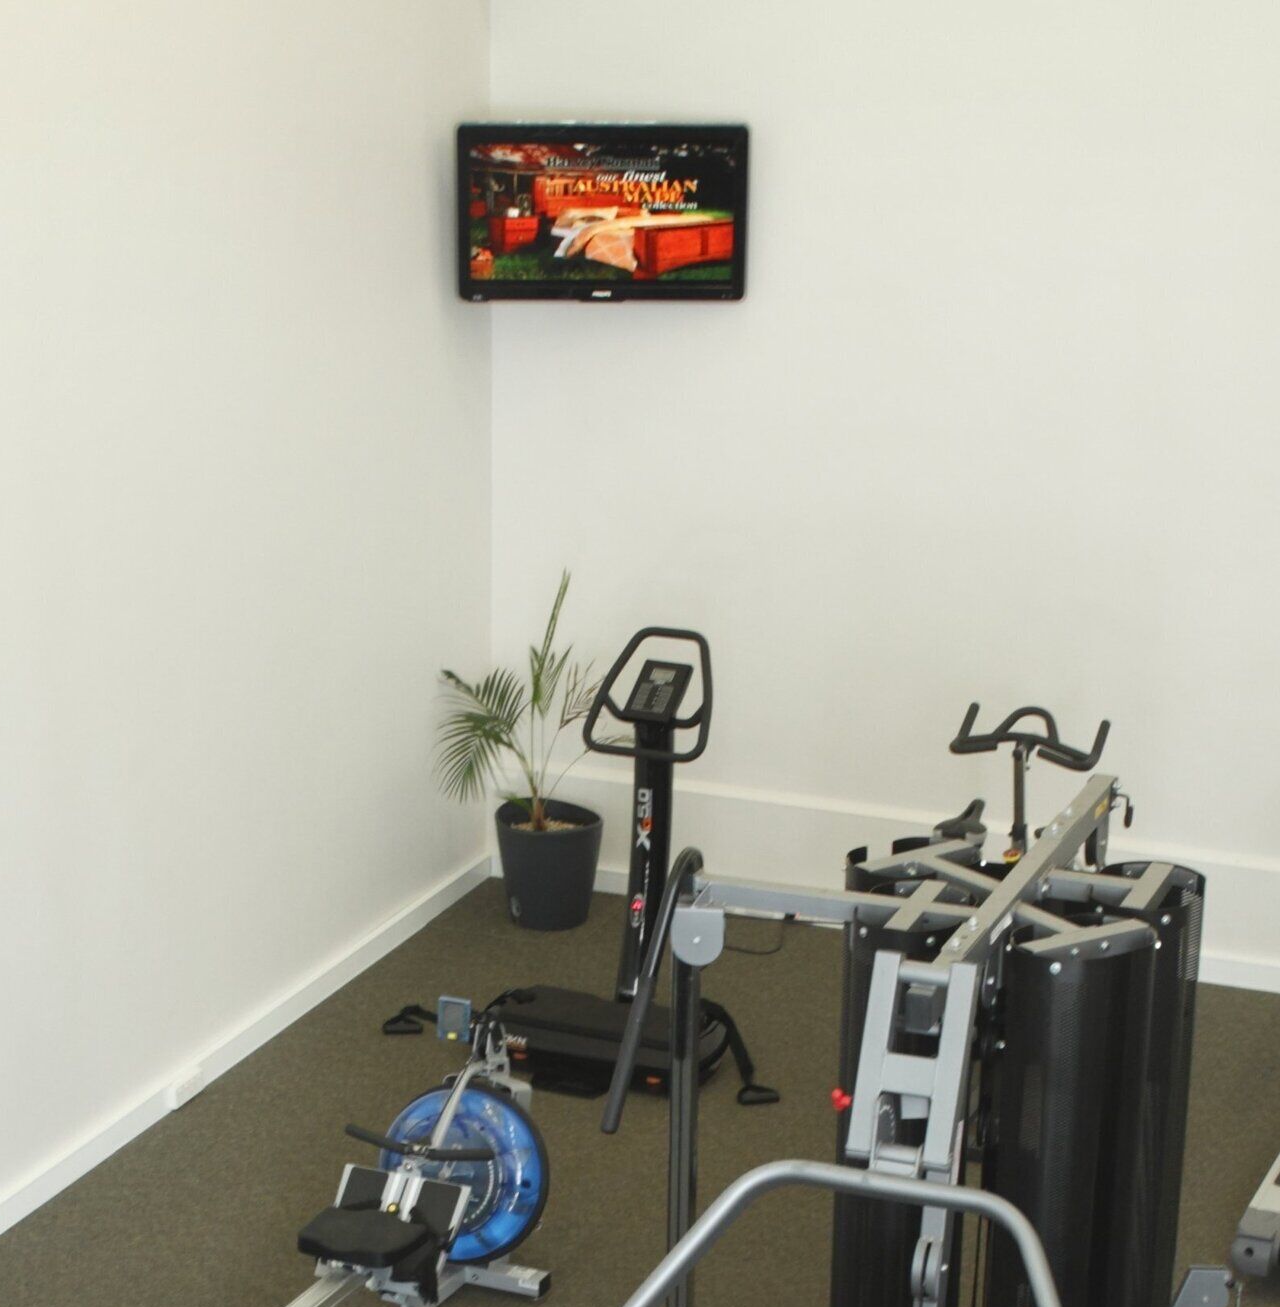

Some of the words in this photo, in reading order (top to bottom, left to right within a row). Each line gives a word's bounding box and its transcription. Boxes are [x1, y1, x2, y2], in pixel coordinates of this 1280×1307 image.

[620, 170, 668, 184] finest
[573, 178, 699, 194] AUSTRALIAN
[622, 190, 684, 203] MADE
[641, 201, 698, 210] collection
